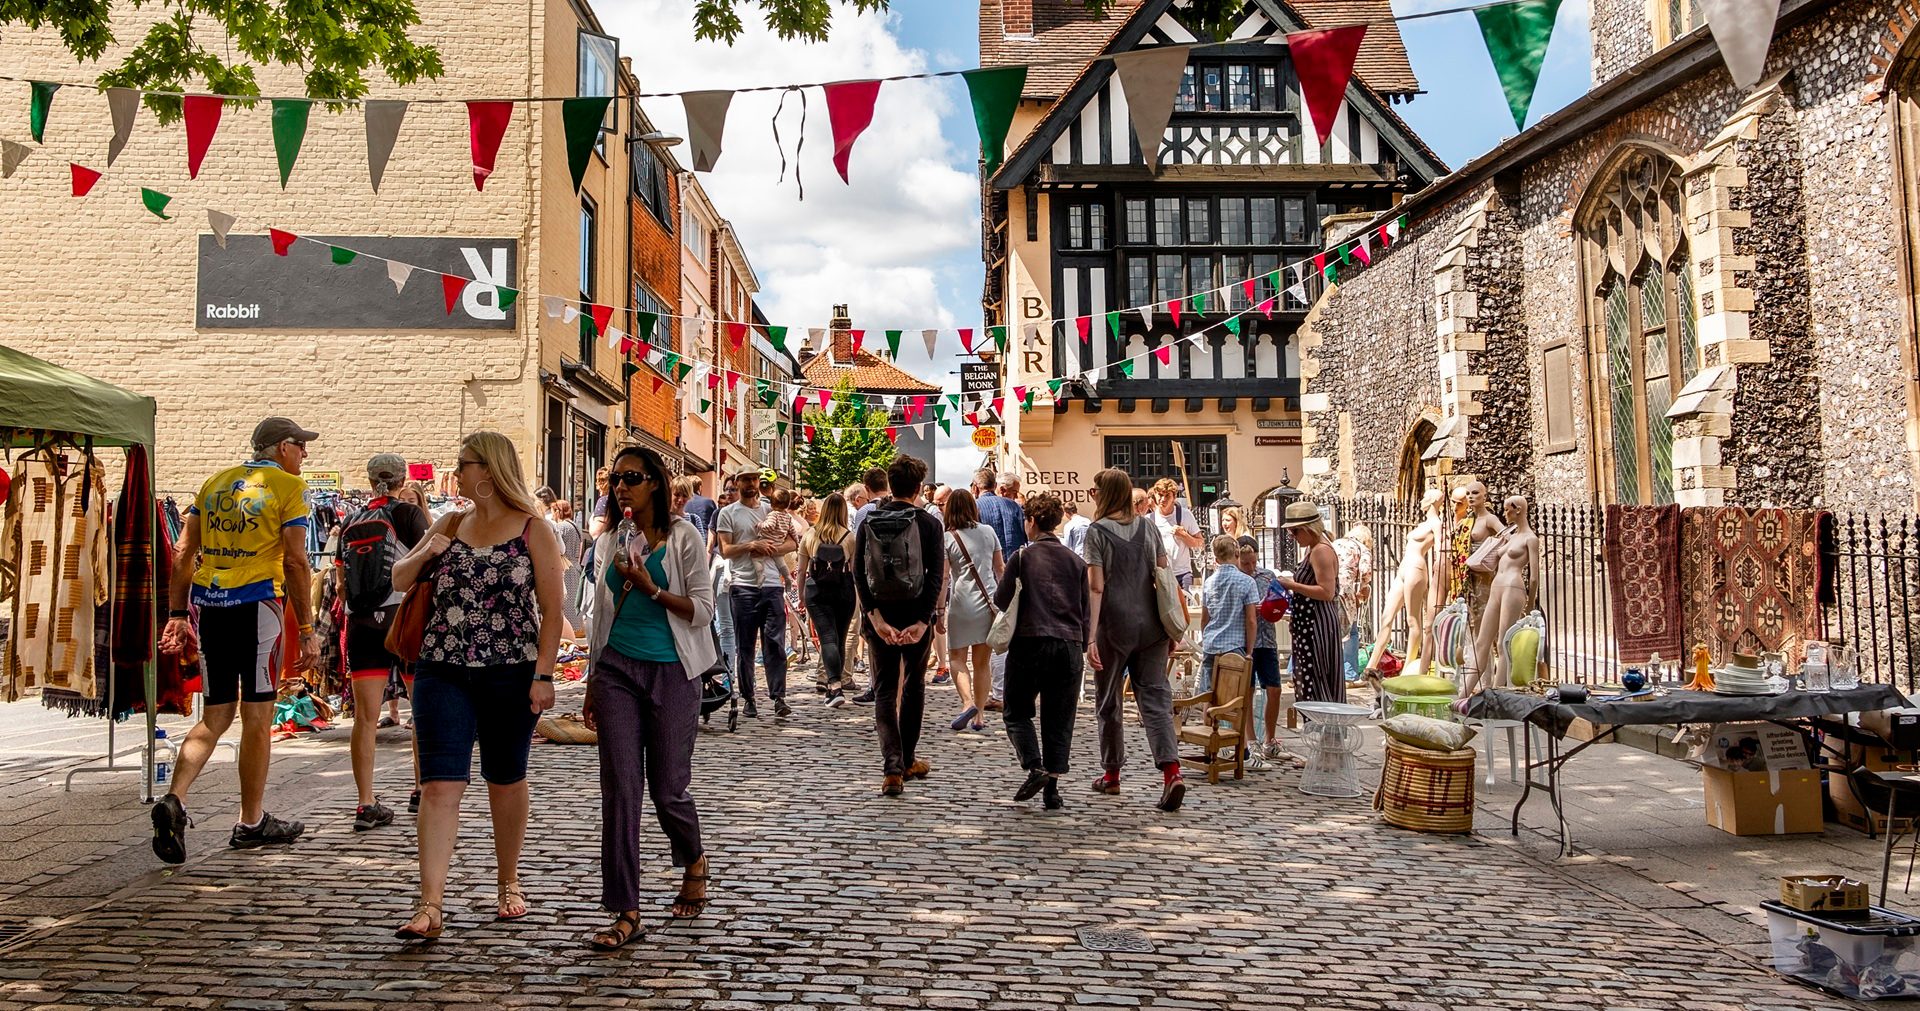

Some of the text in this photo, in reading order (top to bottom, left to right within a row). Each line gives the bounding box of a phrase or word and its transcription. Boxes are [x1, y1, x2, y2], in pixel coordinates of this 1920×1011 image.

[206, 304, 260, 319] Rabbit
[1022, 297, 1047, 373] BAR
[964, 372, 997, 380] BELGIAN
[968, 381, 994, 389] MONK
[1025, 471, 1080, 484] BEER
[1026, 489, 1091, 503] GRDE
